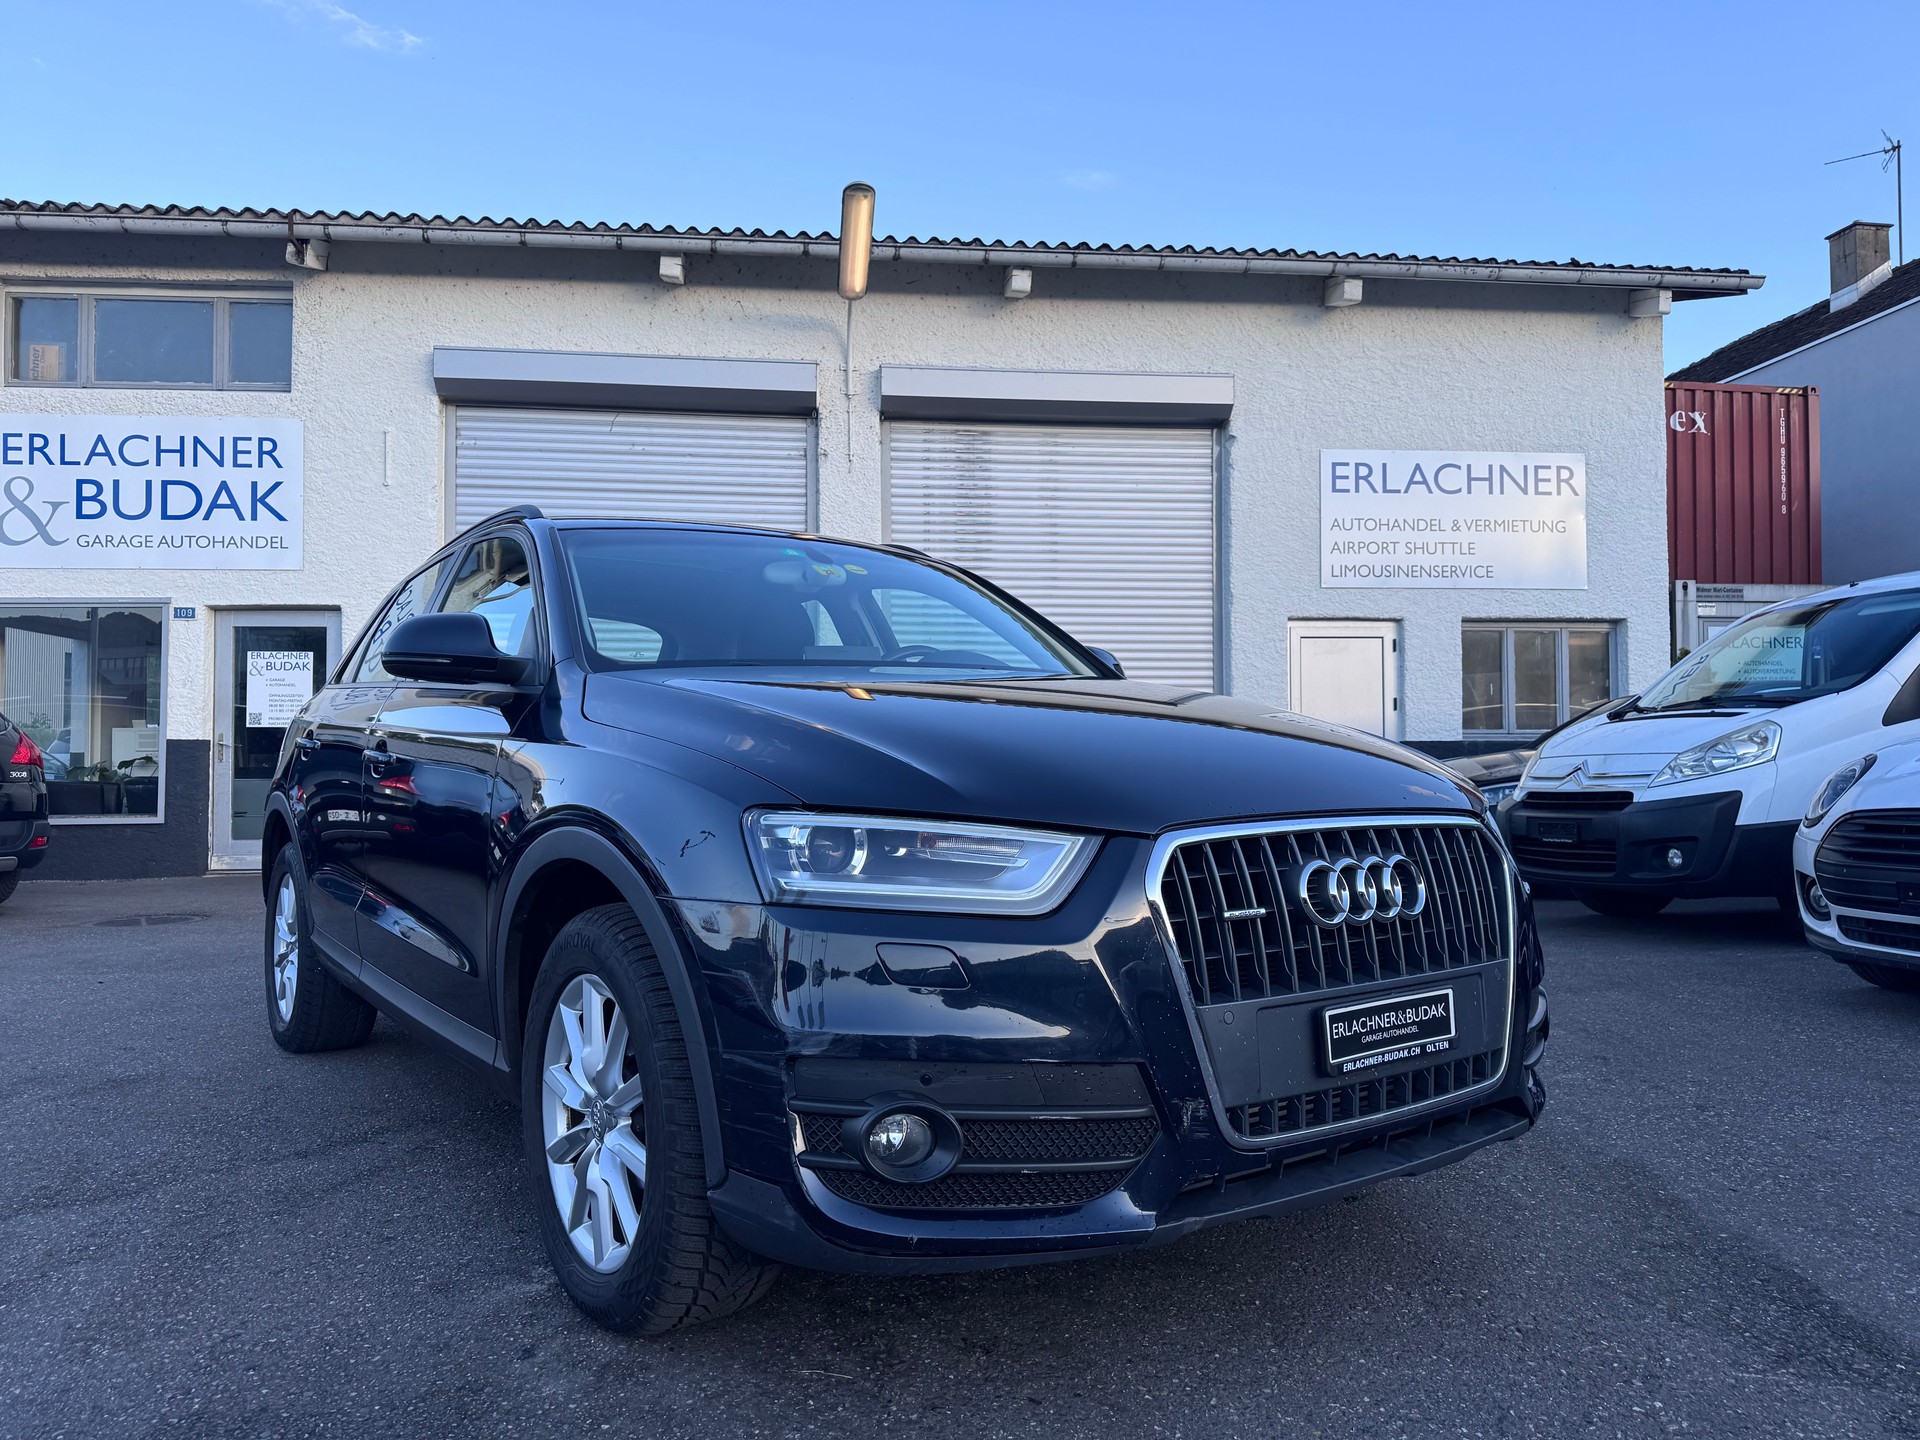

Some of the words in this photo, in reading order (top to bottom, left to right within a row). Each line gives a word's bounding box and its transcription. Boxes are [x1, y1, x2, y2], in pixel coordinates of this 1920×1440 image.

[1670, 410, 1708, 434] ex
[2, 432, 284, 469] ERLACHNER
[1331, 461, 1580, 496] ERLACHNER
[0, 475, 70, 546] &
[75, 478, 289, 522] BUDAK
[1330, 517, 1446, 532] AUTOHANDEL
[1451, 519, 1462, 532] &
[1464, 518, 1567, 534] VERMIETUNG
[76, 534, 153, 548] GARAGE
[157, 535, 289, 549] AUTOHANDEL
[1330, 541, 1400, 555] AIRPORT
[1405, 541, 1476, 555] SHUTTLE
[1331, 564, 1494, 579] LIMOUSINENSERVICE
[176, 608, 193, 617] 109
[1728, 636, 1805, 649] LACHNER
[250, 652, 310, 660] ERLACHNER
[249, 660, 265, 676] &
[265, 661, 311, 671] BUDAK
[1332, 1002, 1447, 1039] ERLACHNER&BUDAK
[1361, 1032, 1384, 1044] GARAGE
[1382, 1025, 1419, 1040] AUTOHANDEL
[1343, 1046, 1421, 1073] ERLACHNER-BUDAK.CH
[1426, 1040, 1449, 1053] OLTEN
